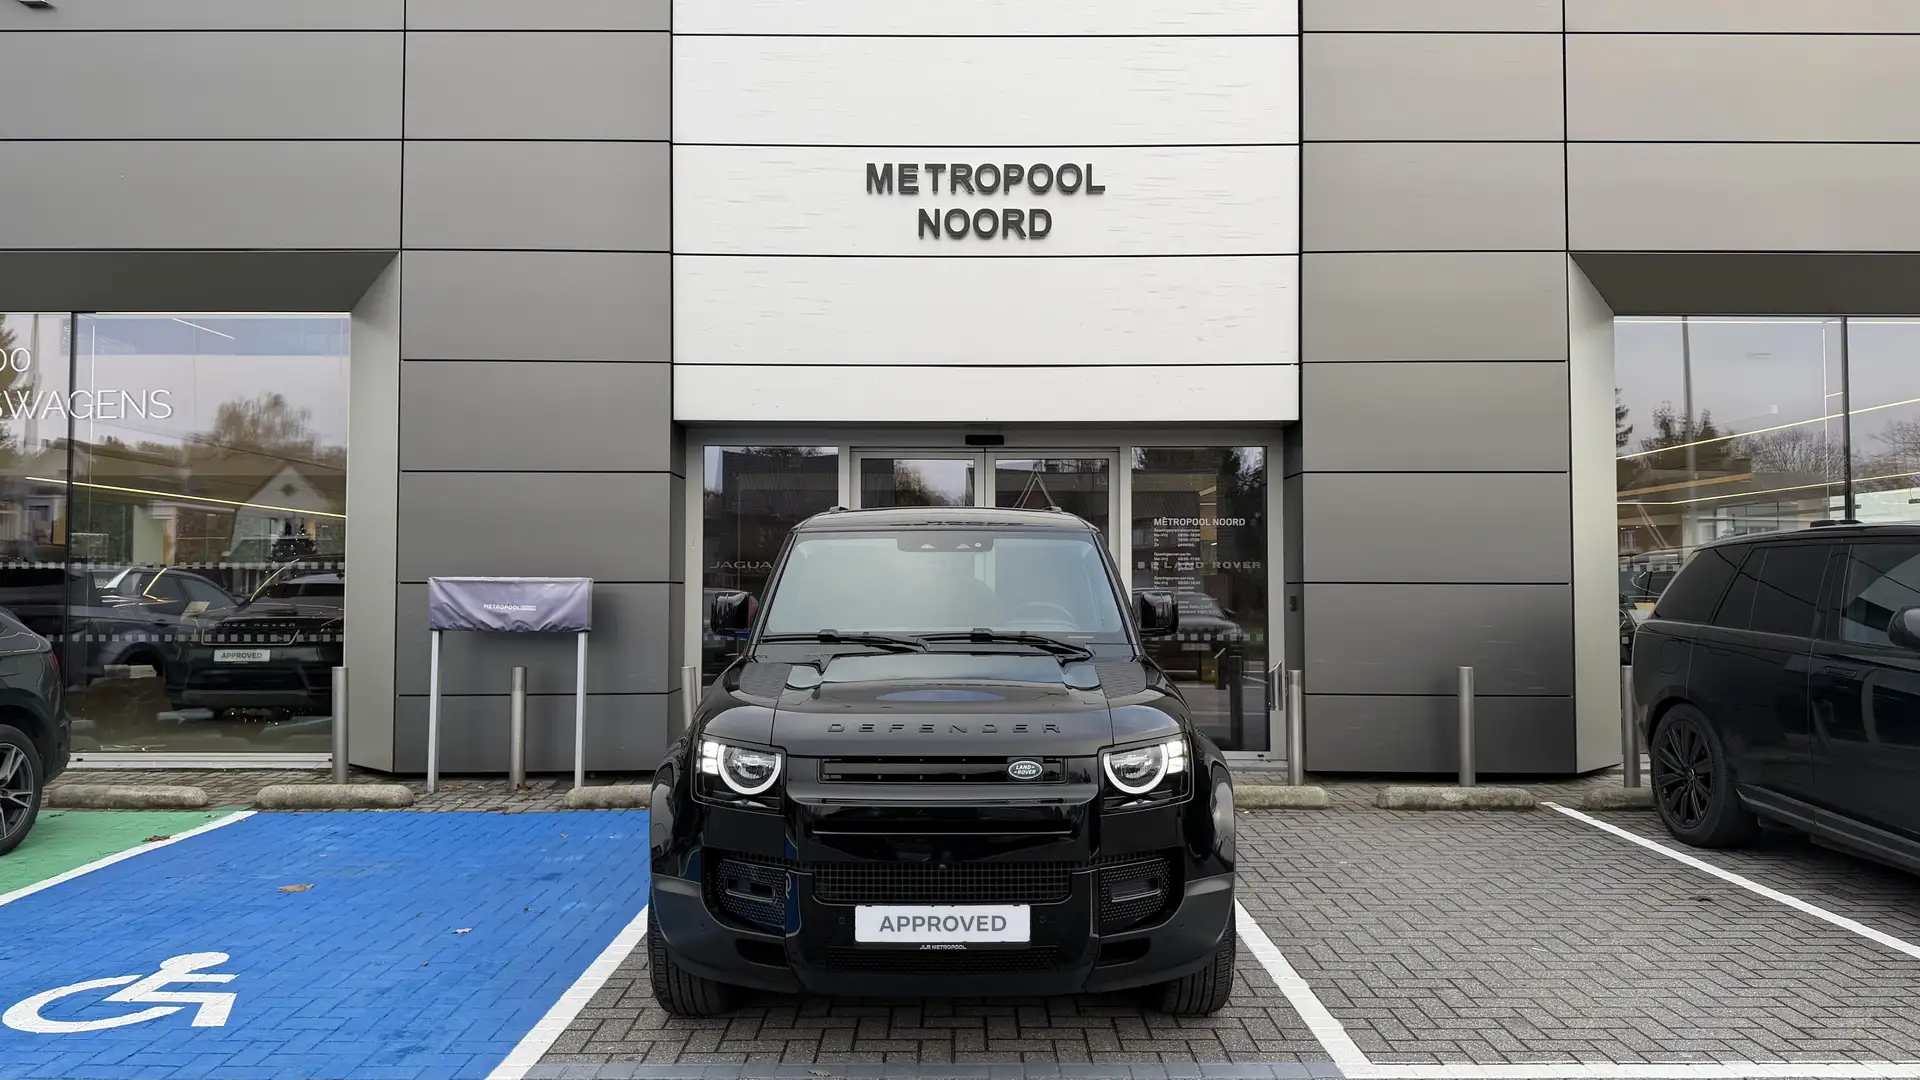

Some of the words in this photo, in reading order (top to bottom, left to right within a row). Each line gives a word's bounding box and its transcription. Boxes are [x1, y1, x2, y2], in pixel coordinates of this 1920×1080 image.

[866, 163, 1106, 194] METROPOOL
[918, 208, 1052, 238] NOORD
[0, 389, 173, 419] WAGENS
[1153, 517, 1211, 526] METROPOOL
[1212, 518, 1246, 526] NOORD
[710, 561, 773, 569] JAGUA
[1212, 561, 1261, 569] ROVER
[221, 652, 263, 660] APPROVED
[827, 723, 1061, 734] DEFENDER
[878, 915, 1008, 933] APPROVED
